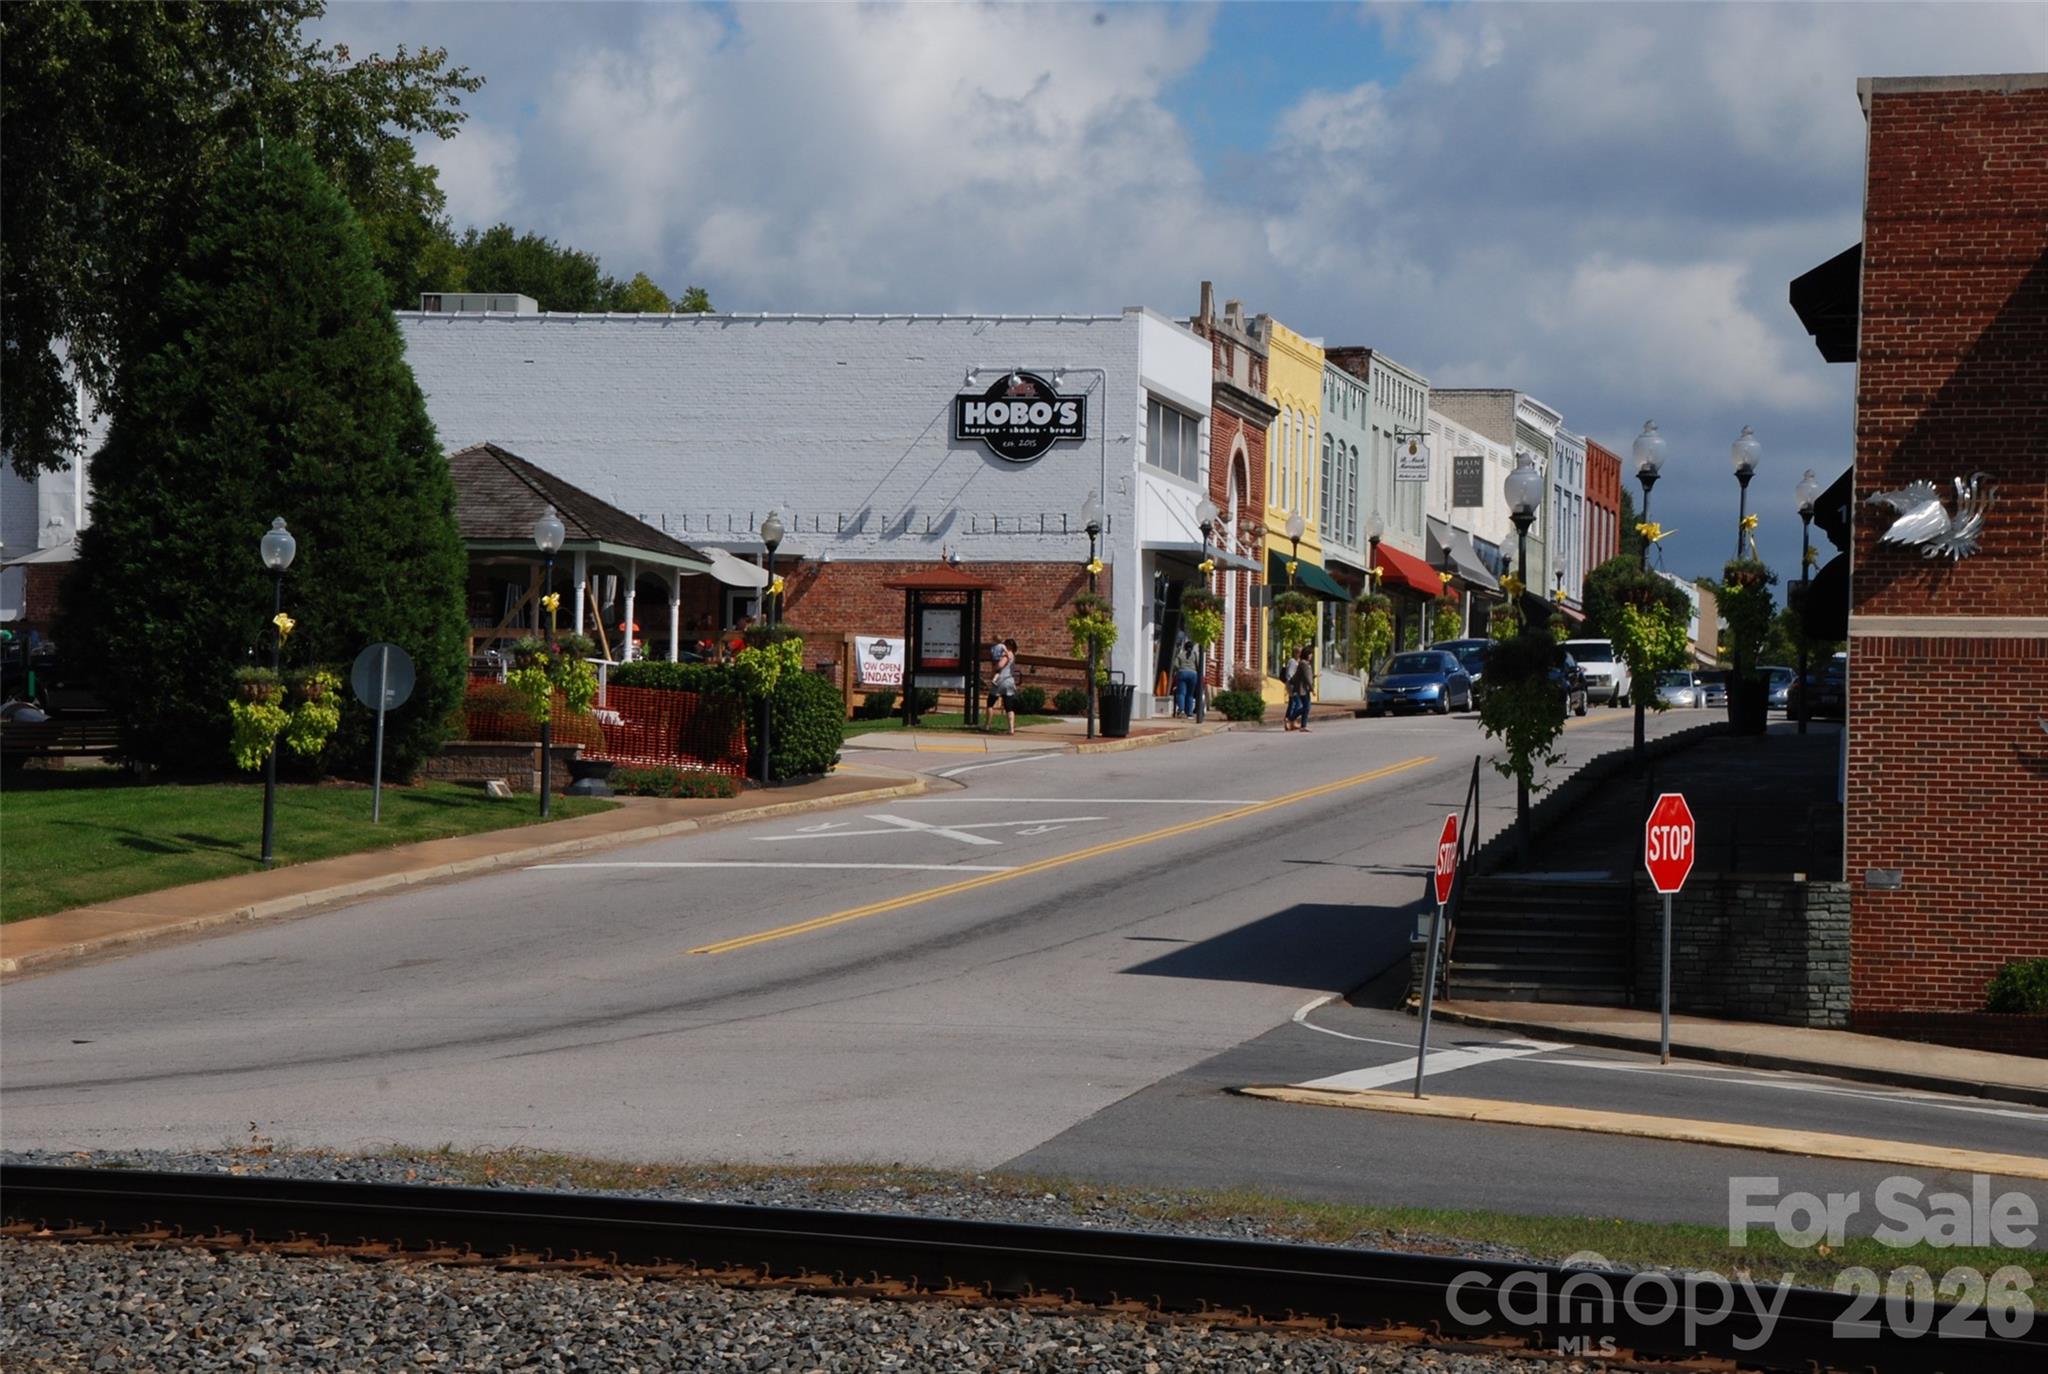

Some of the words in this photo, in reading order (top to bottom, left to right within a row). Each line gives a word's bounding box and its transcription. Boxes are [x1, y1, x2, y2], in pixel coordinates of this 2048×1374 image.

[965, 401, 1078, 425] HOBO'S
[1456, 468, 1481, 476] GRAY
[879, 663, 901, 672] OPEN
[1649, 825, 1692, 861] STOP
[1437, 842, 1458, 876] STOP
